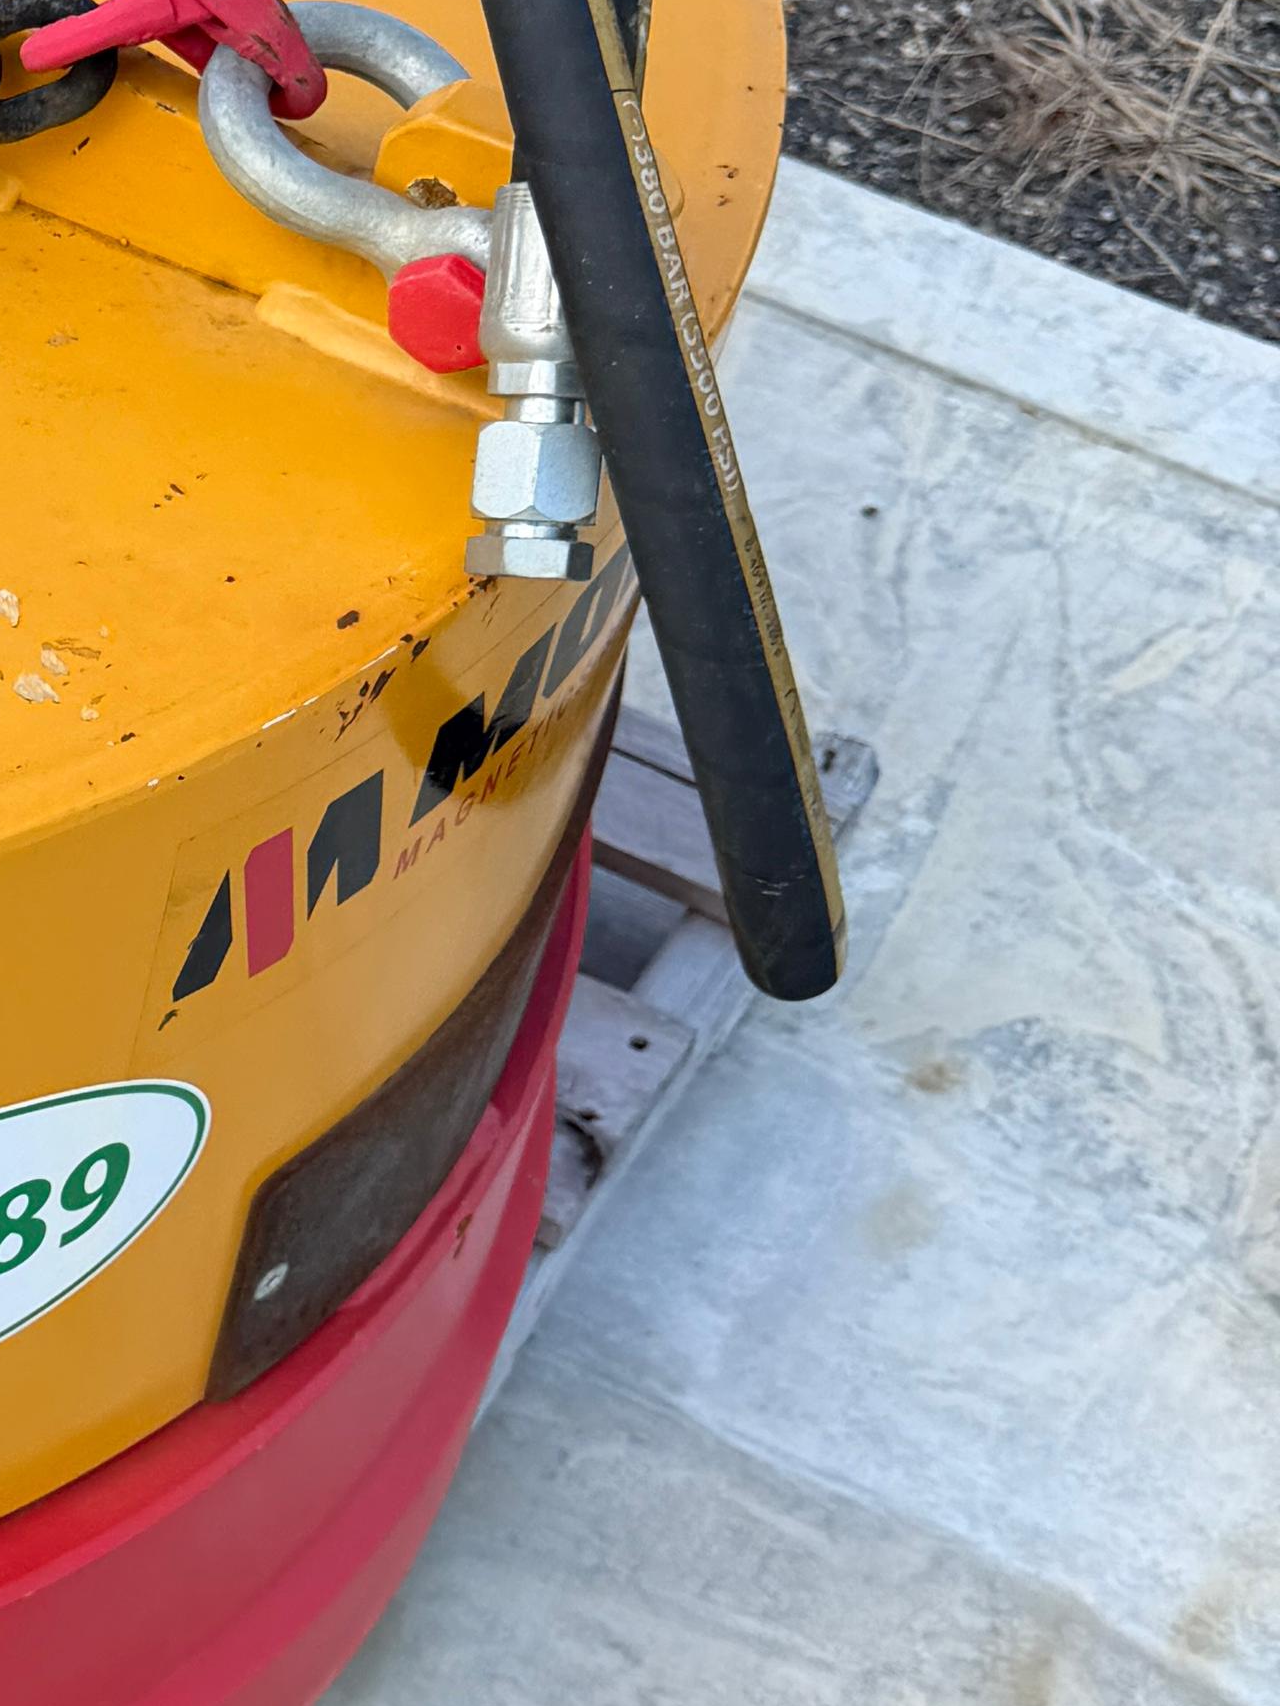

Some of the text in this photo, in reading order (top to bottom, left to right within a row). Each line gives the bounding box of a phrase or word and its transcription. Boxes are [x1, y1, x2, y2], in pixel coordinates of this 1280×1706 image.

[633, 142, 666, 213] 380
[655, 225, 691, 305] BAR
[393, 686, 574, 880] MAGNETIC
